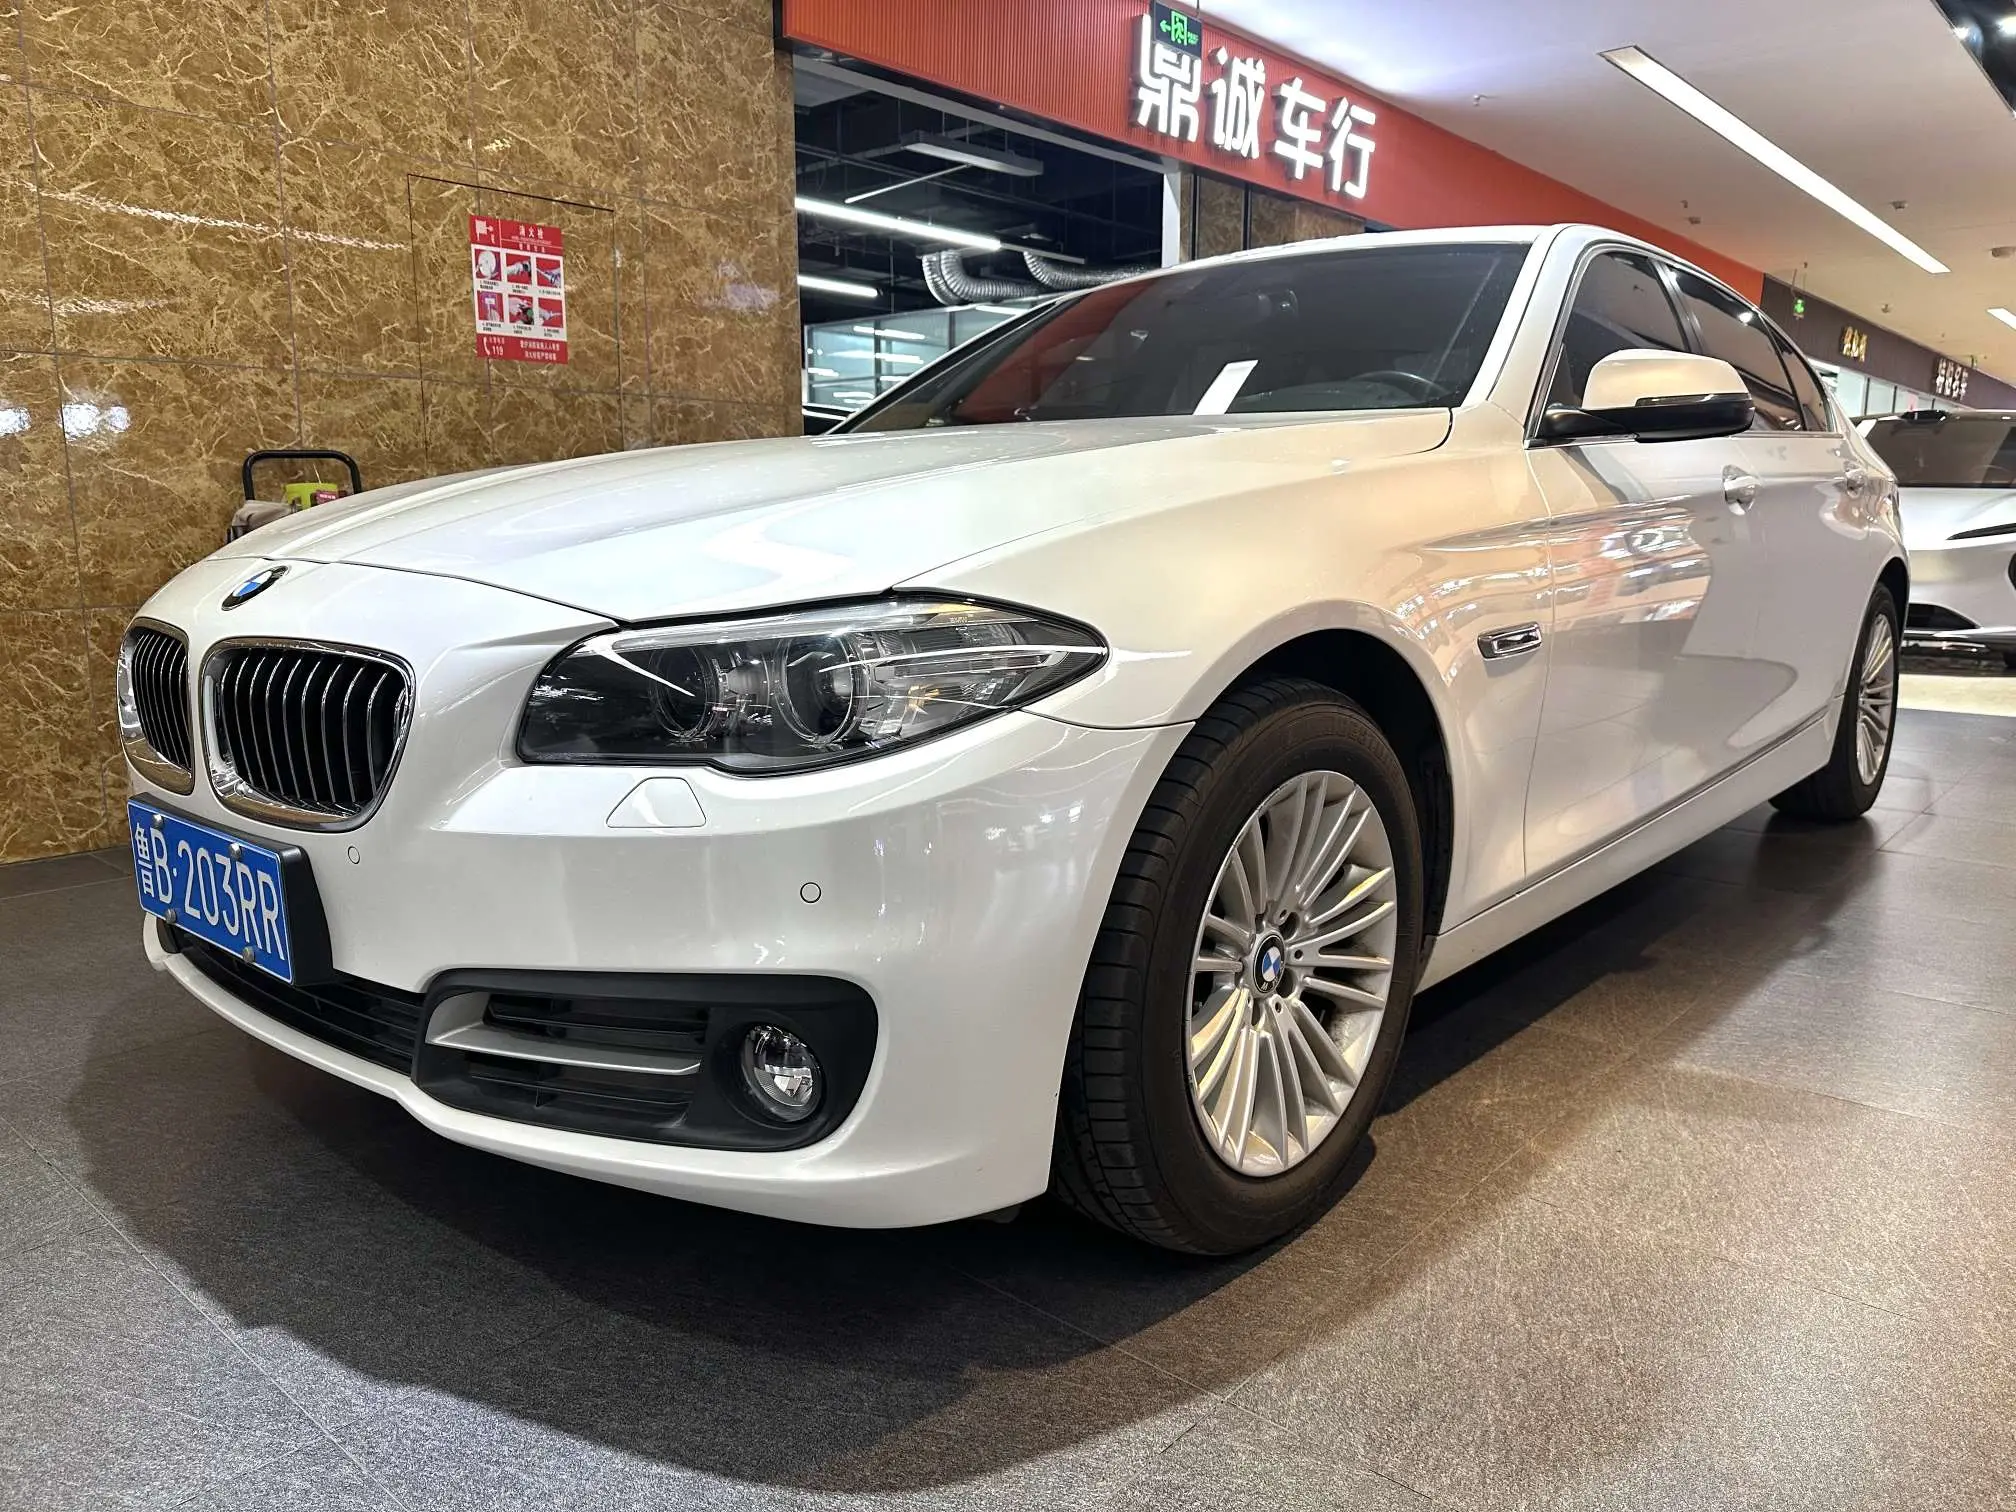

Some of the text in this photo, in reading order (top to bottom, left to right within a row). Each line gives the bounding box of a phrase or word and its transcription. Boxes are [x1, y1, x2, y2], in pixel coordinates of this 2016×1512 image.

[1137, 14, 1377, 199] 鼎诚车行
[492, 345, 504, 356] 119
